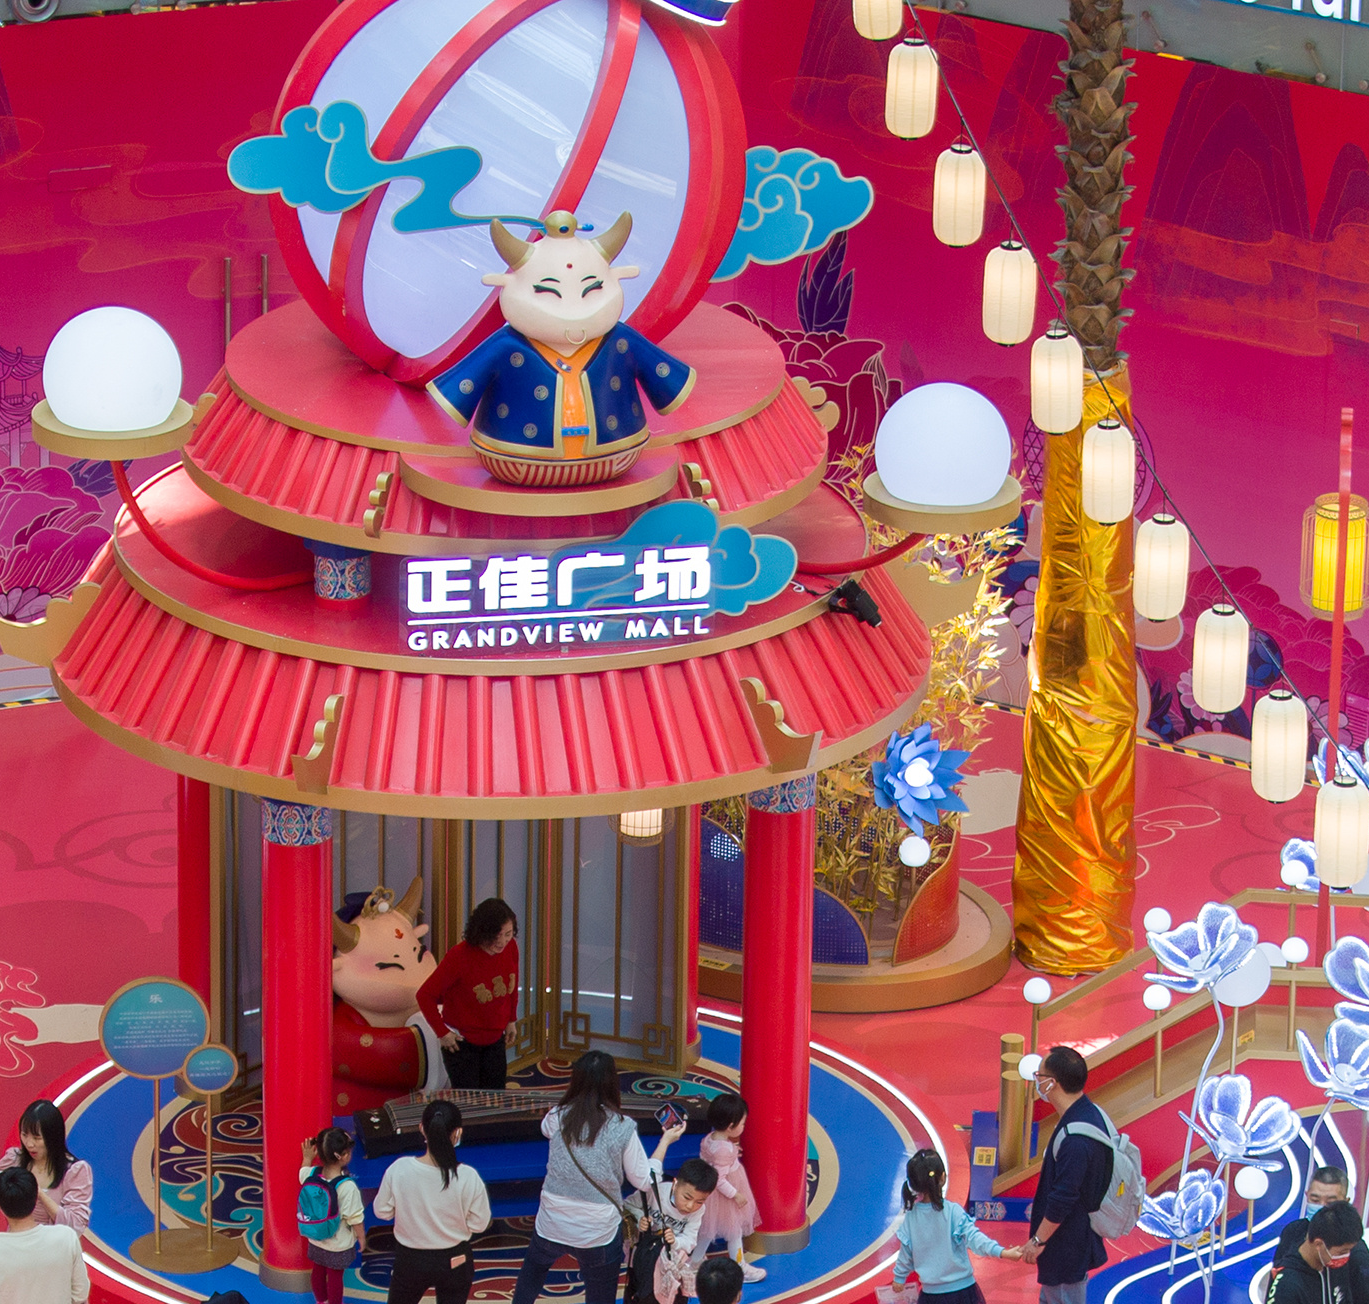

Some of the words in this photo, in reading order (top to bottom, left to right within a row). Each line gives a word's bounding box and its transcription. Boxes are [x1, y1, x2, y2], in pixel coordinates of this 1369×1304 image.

[407, 545, 711, 614] 正佳广场
[407, 621, 604, 651] GRANDVIEW
[624, 614, 711, 640] MALL
